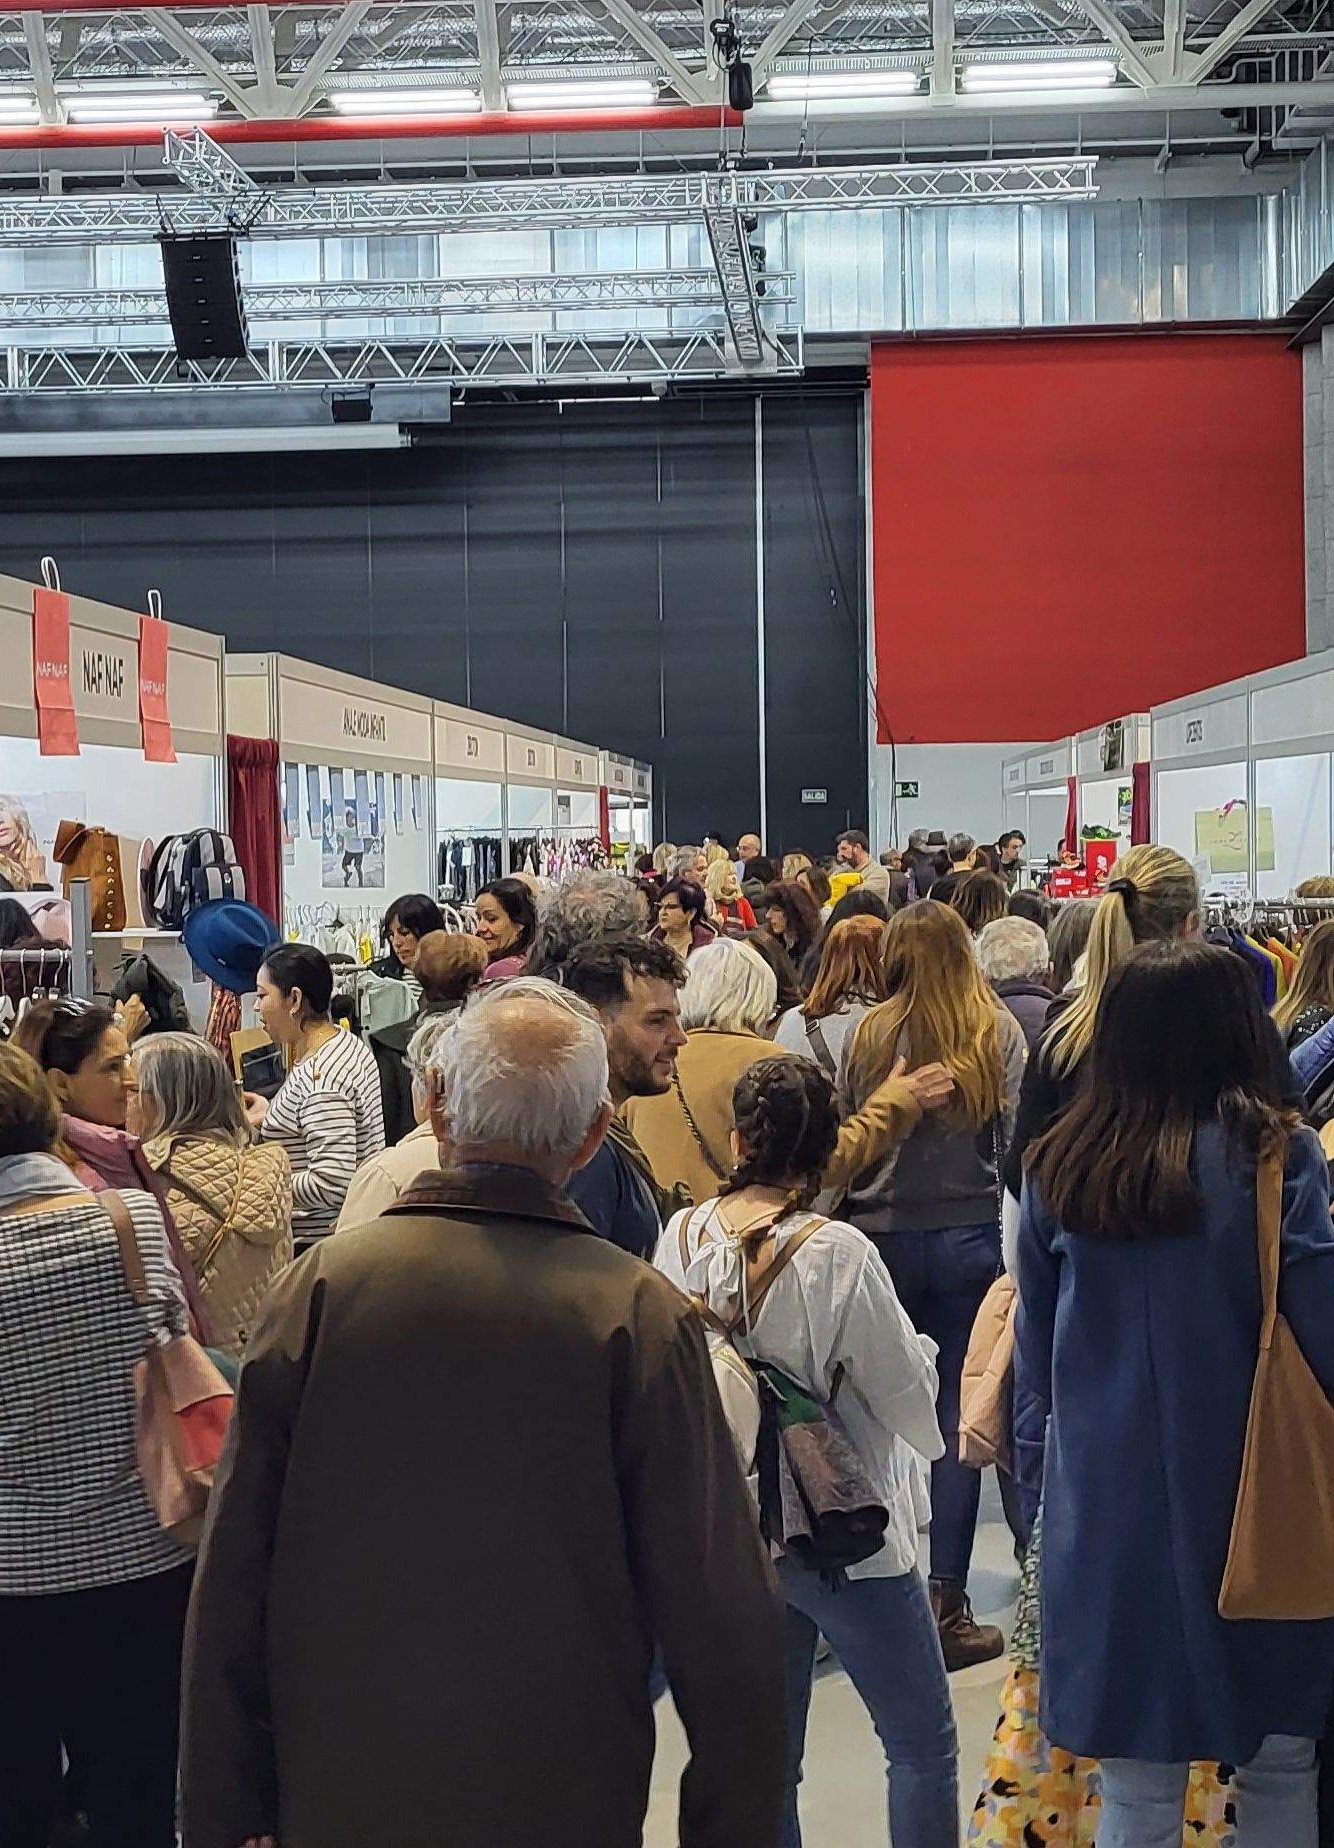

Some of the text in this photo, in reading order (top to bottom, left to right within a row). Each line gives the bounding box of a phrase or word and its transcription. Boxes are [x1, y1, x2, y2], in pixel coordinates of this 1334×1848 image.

[37, 661, 68, 679] NAF NAF
[83, 649, 124, 698] NAF NAF
